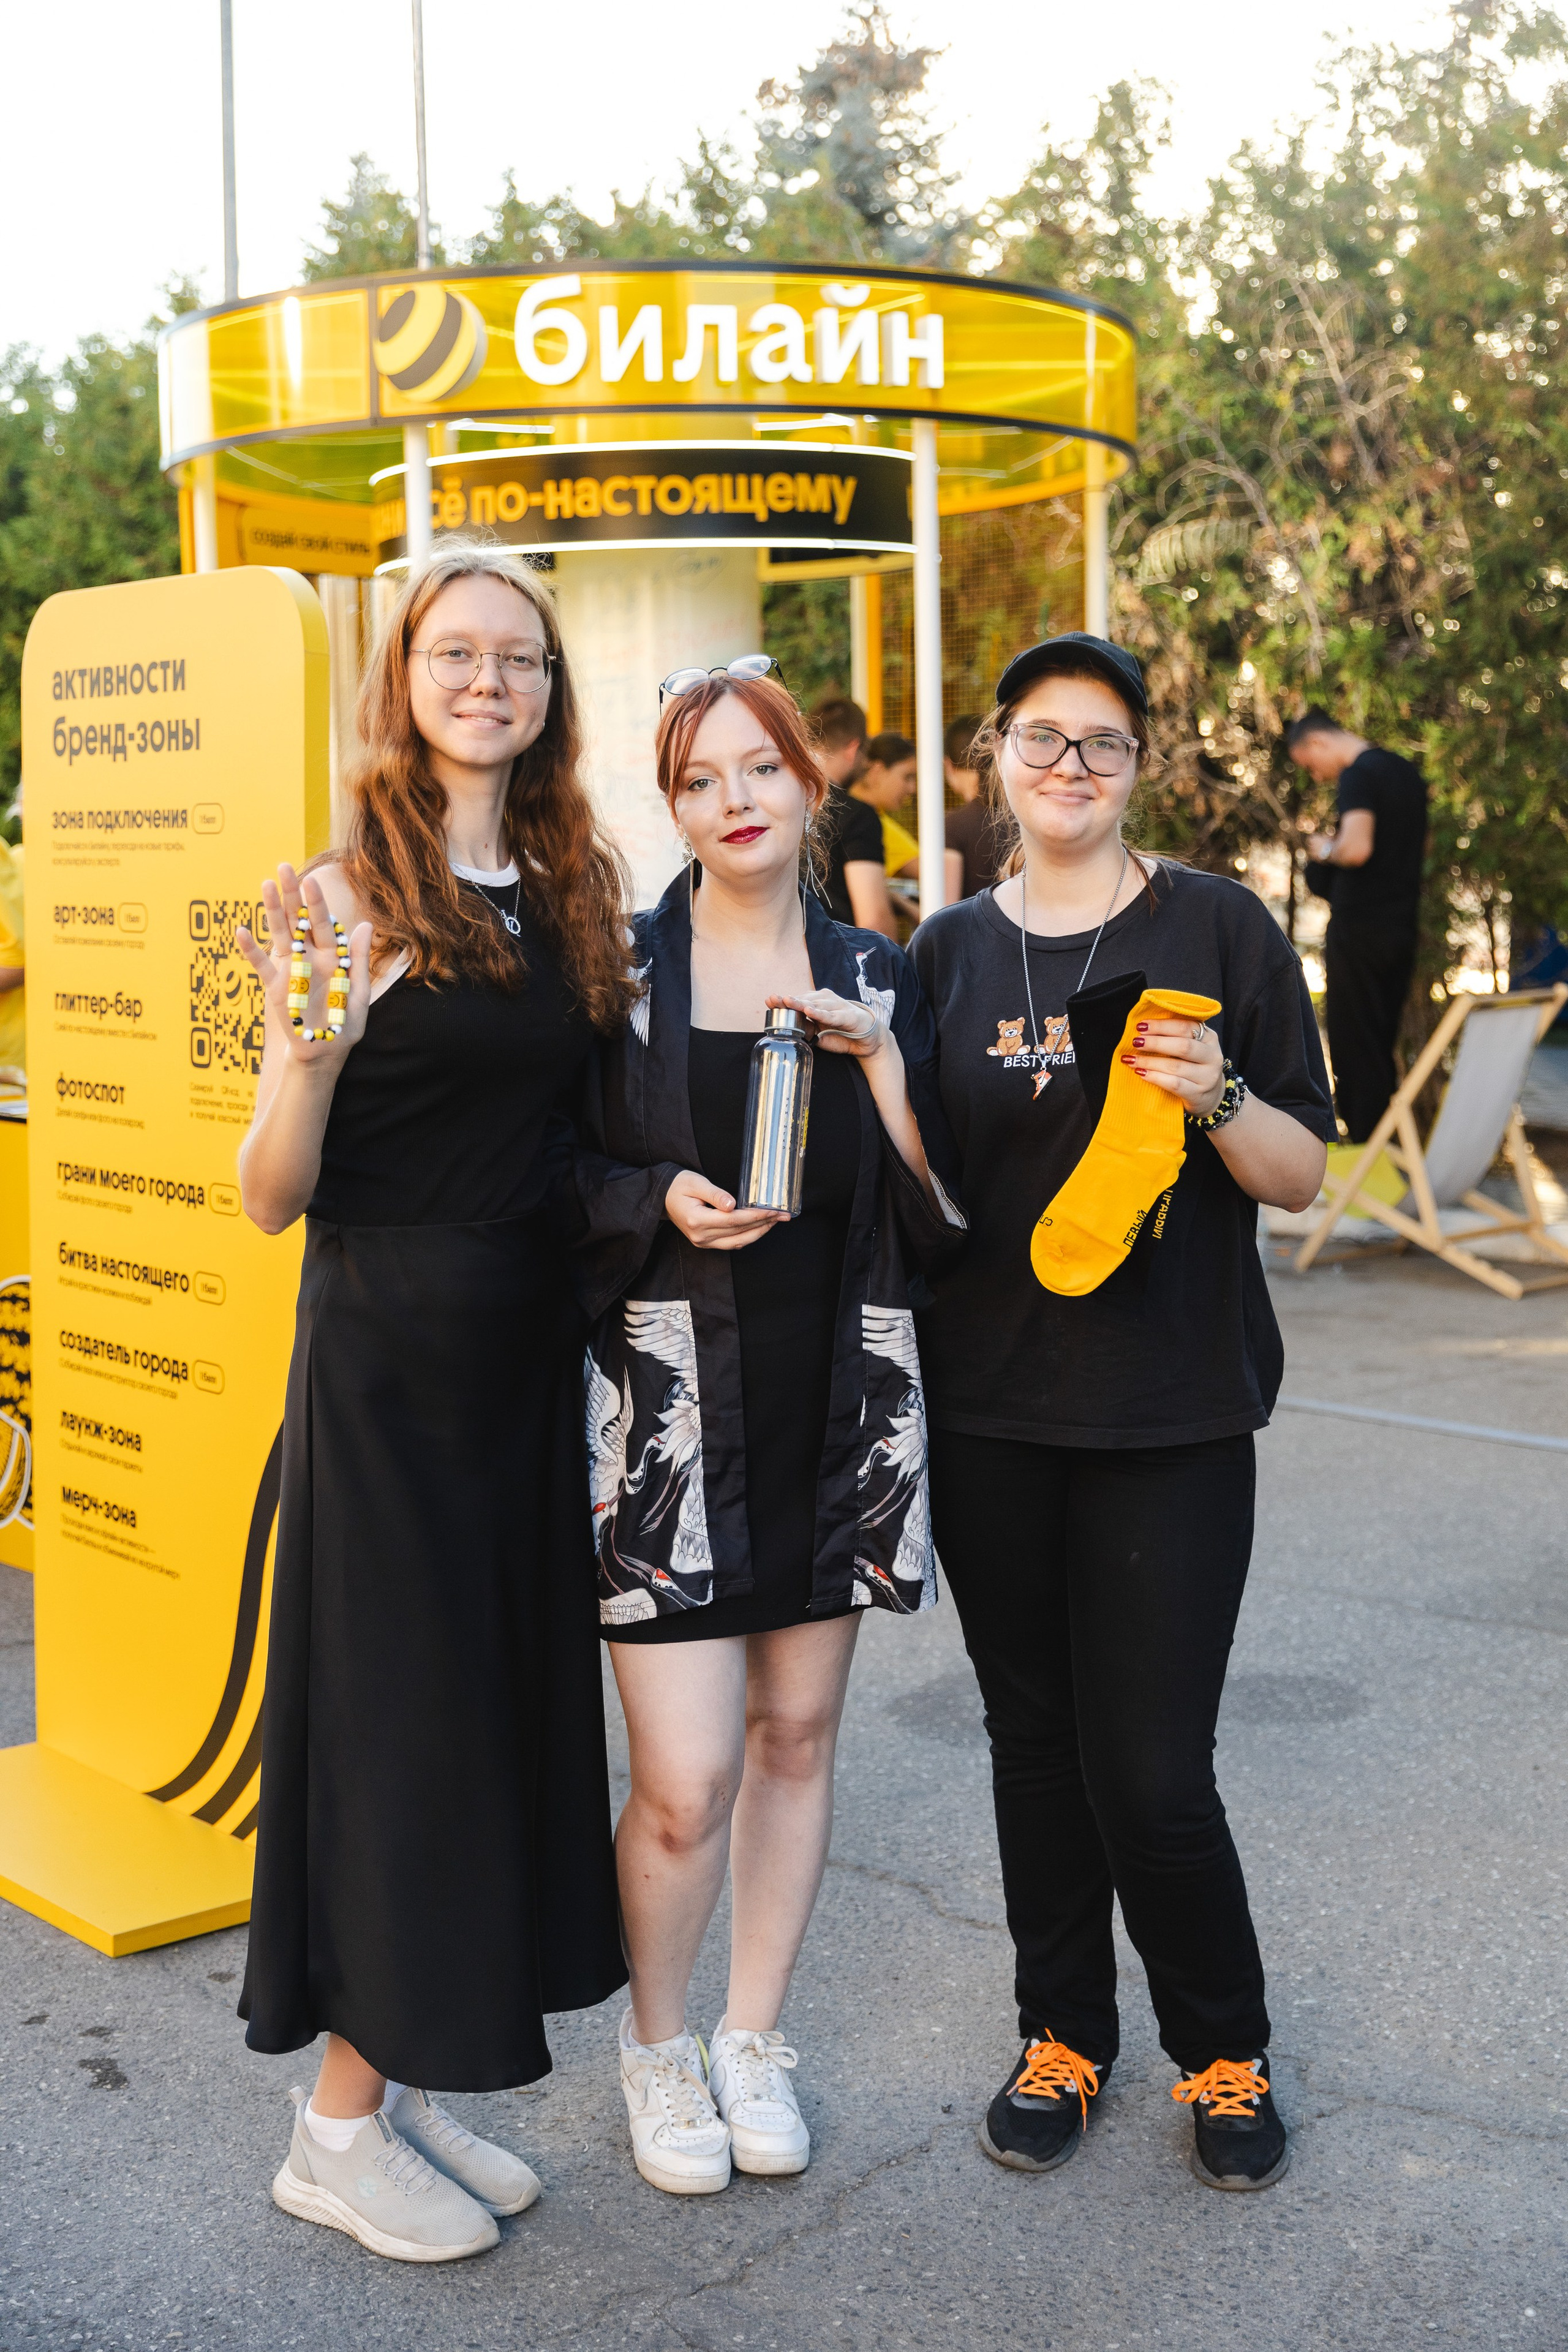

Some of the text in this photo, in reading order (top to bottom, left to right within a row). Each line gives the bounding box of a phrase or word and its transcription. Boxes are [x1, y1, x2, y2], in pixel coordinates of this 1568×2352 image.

[514, 274, 945, 390] билайн
[470, 472, 856, 526] по-настоящему
[52, 658, 186, 701] активности
[53, 715, 200, 766] бренд-зоны
[52, 808, 188, 834] зона подключения
[54, 905, 115, 929] арт-зона
[55, 991, 143, 1023] глиттер-бар
[1004, 1050, 1076, 1068] BEST FRIE
[56, 1071, 126, 1105] фотоспот
[57, 1161, 96, 1186] грани
[99, 1169, 146, 1194] моего
[149, 1177, 205, 1210] города
[59, 1241, 97, 1273] битва
[100, 1256, 190, 1293] настоящего
[59, 1330, 131, 1365] создатель
[134, 1349, 189, 1384] города
[60, 1410, 142, 1453] лаунж-зона
[61, 1485, 137, 1529] мерч-зона
